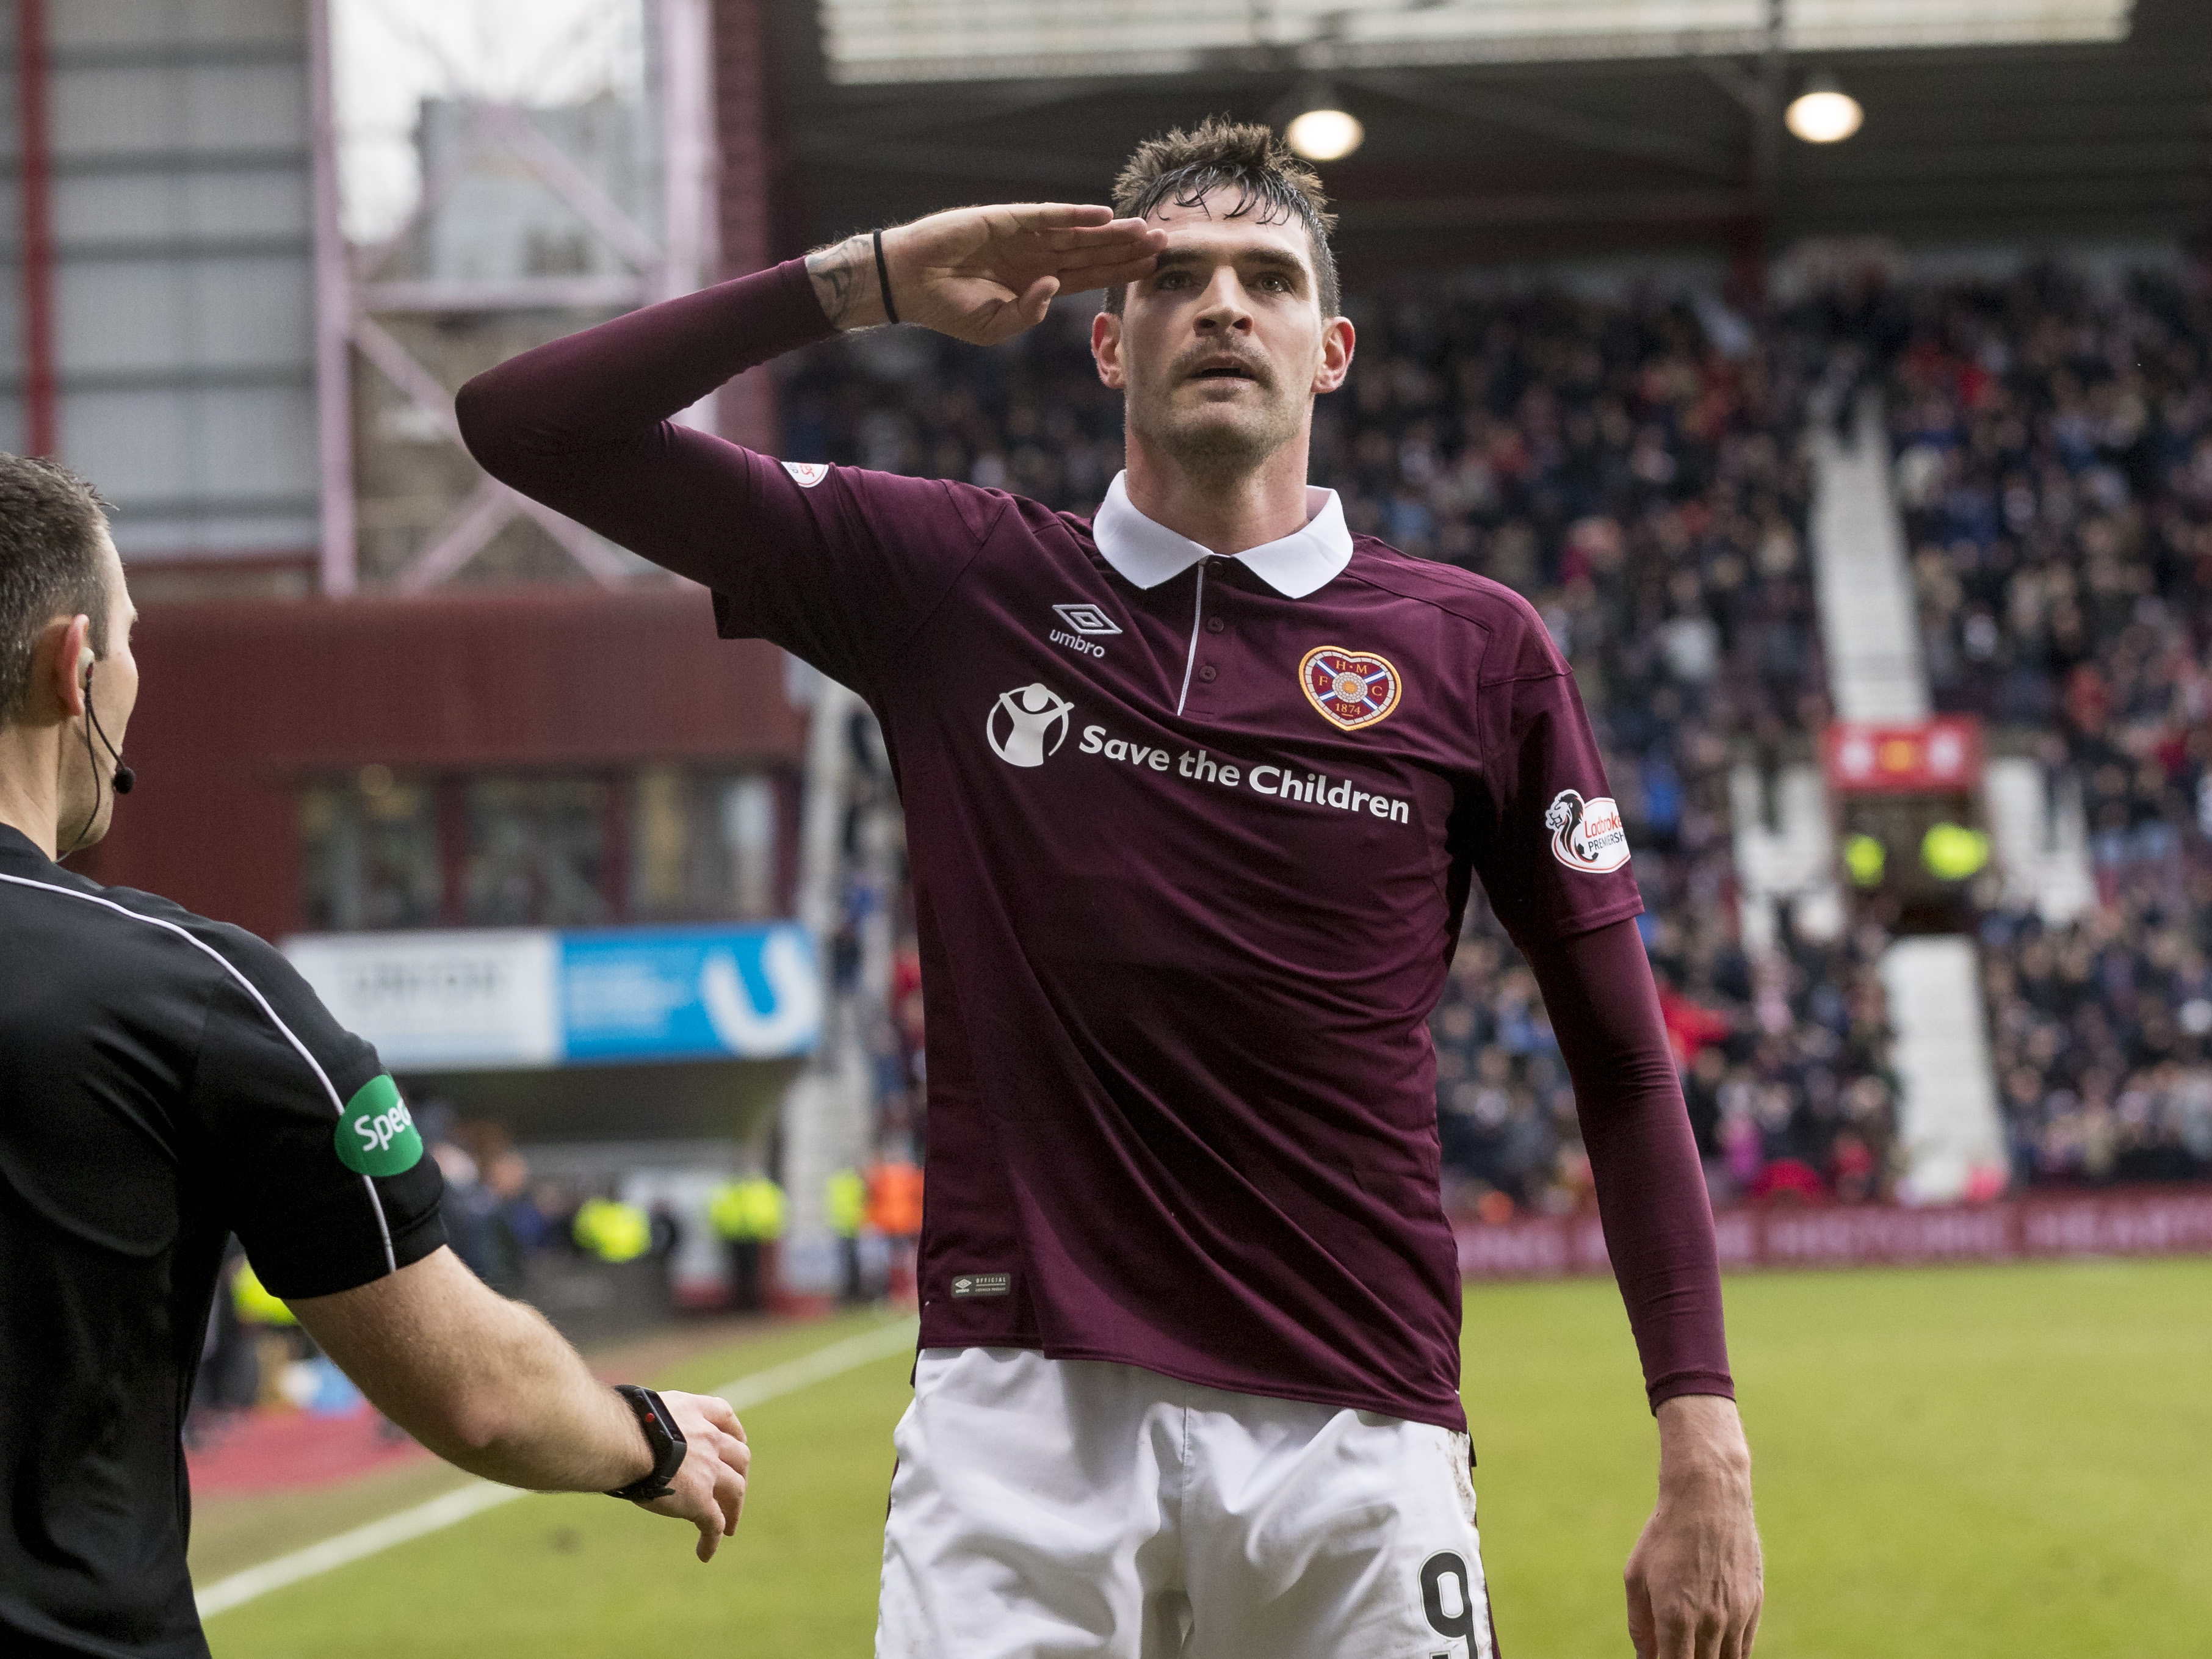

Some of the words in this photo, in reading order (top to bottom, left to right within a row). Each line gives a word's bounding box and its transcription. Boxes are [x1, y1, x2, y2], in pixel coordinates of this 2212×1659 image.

[1049, 629, 1105, 658] umbro
[1318, 676, 1328, 686] F
[1372, 685, 1382, 696] C
[1335, 703, 1361, 715] 1874
[1079, 725, 1169, 772] Save
[1179, 750, 1240, 787] the
[1249, 765, 1409, 825] Children
[1419, 1551, 1478, 1659] 9
